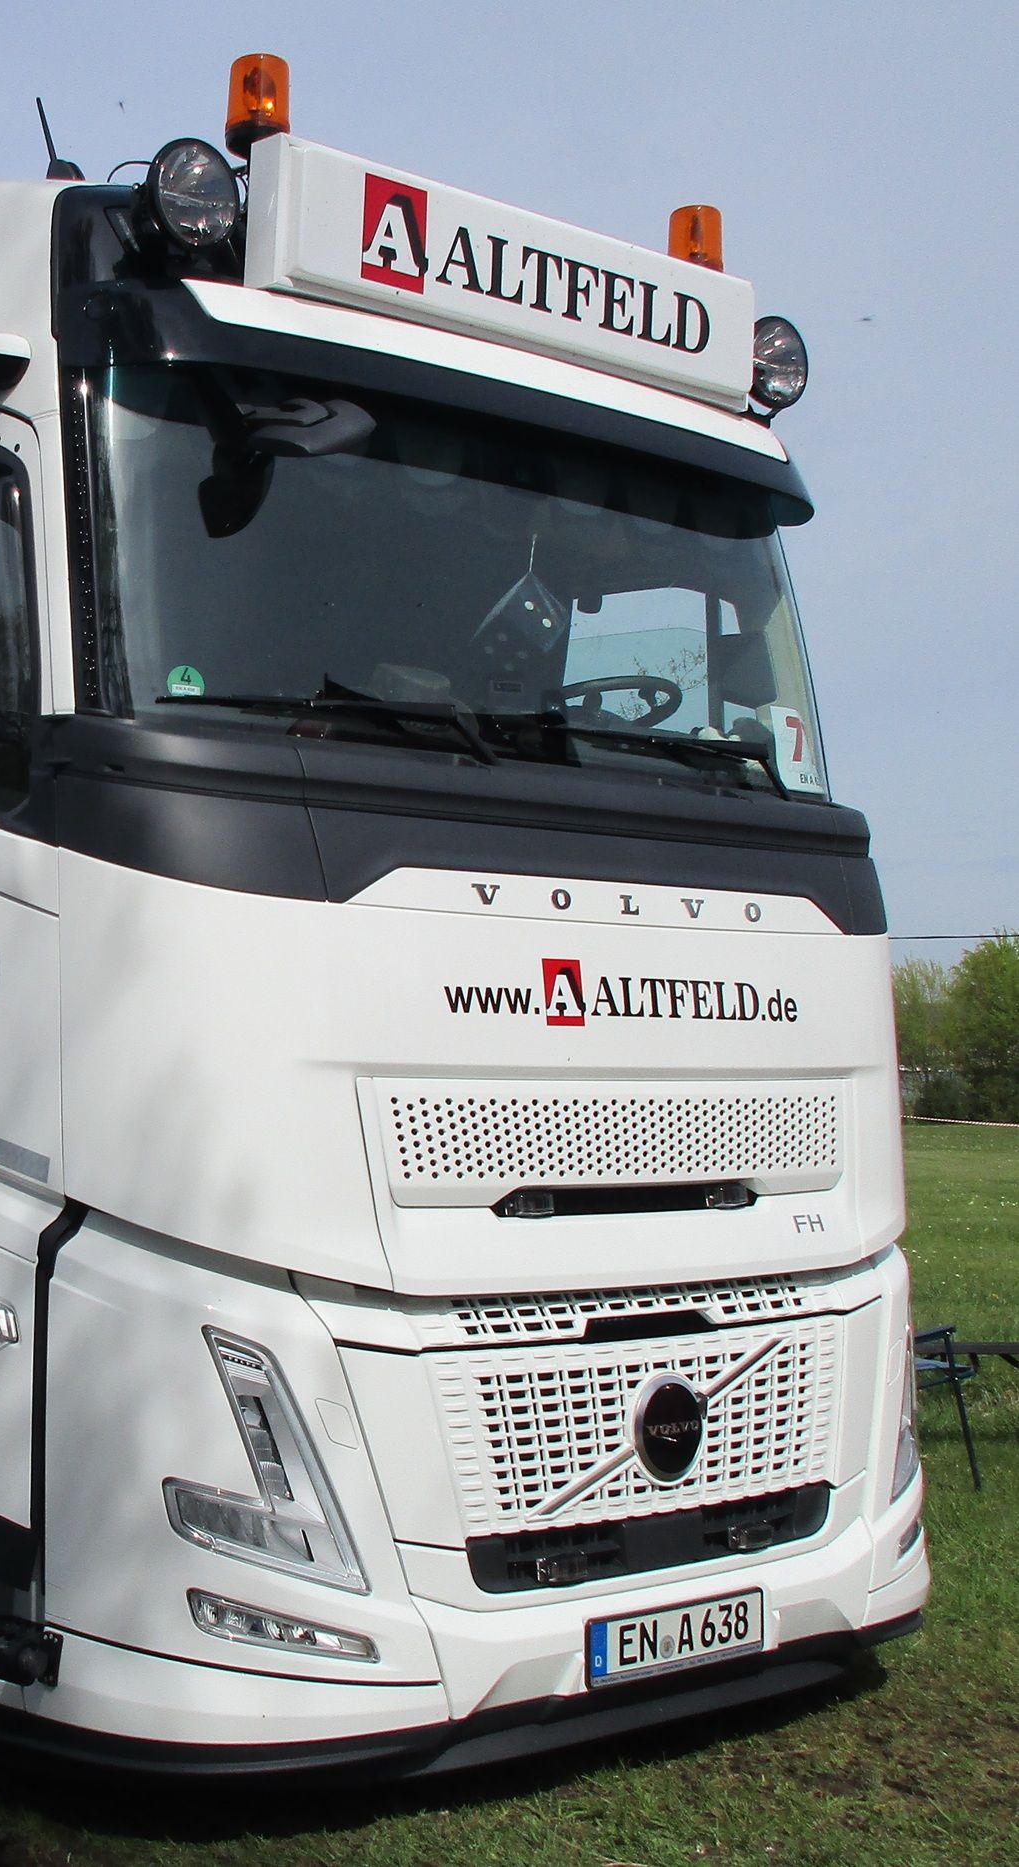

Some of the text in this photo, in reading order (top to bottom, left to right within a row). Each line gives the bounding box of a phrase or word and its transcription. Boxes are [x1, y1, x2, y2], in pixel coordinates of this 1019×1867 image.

[363, 194, 711, 354] A ALTFELD
[180, 667, 192, 686] 4
[785, 715, 803, 762] 7
[471, 883, 762, 923] VOLVO
[793, 1214, 825, 1234] FH
[646, 1420, 700, 1437] VOLVO
[594, 1655, 602, 1667] D
[619, 1618, 658, 1666] EN
